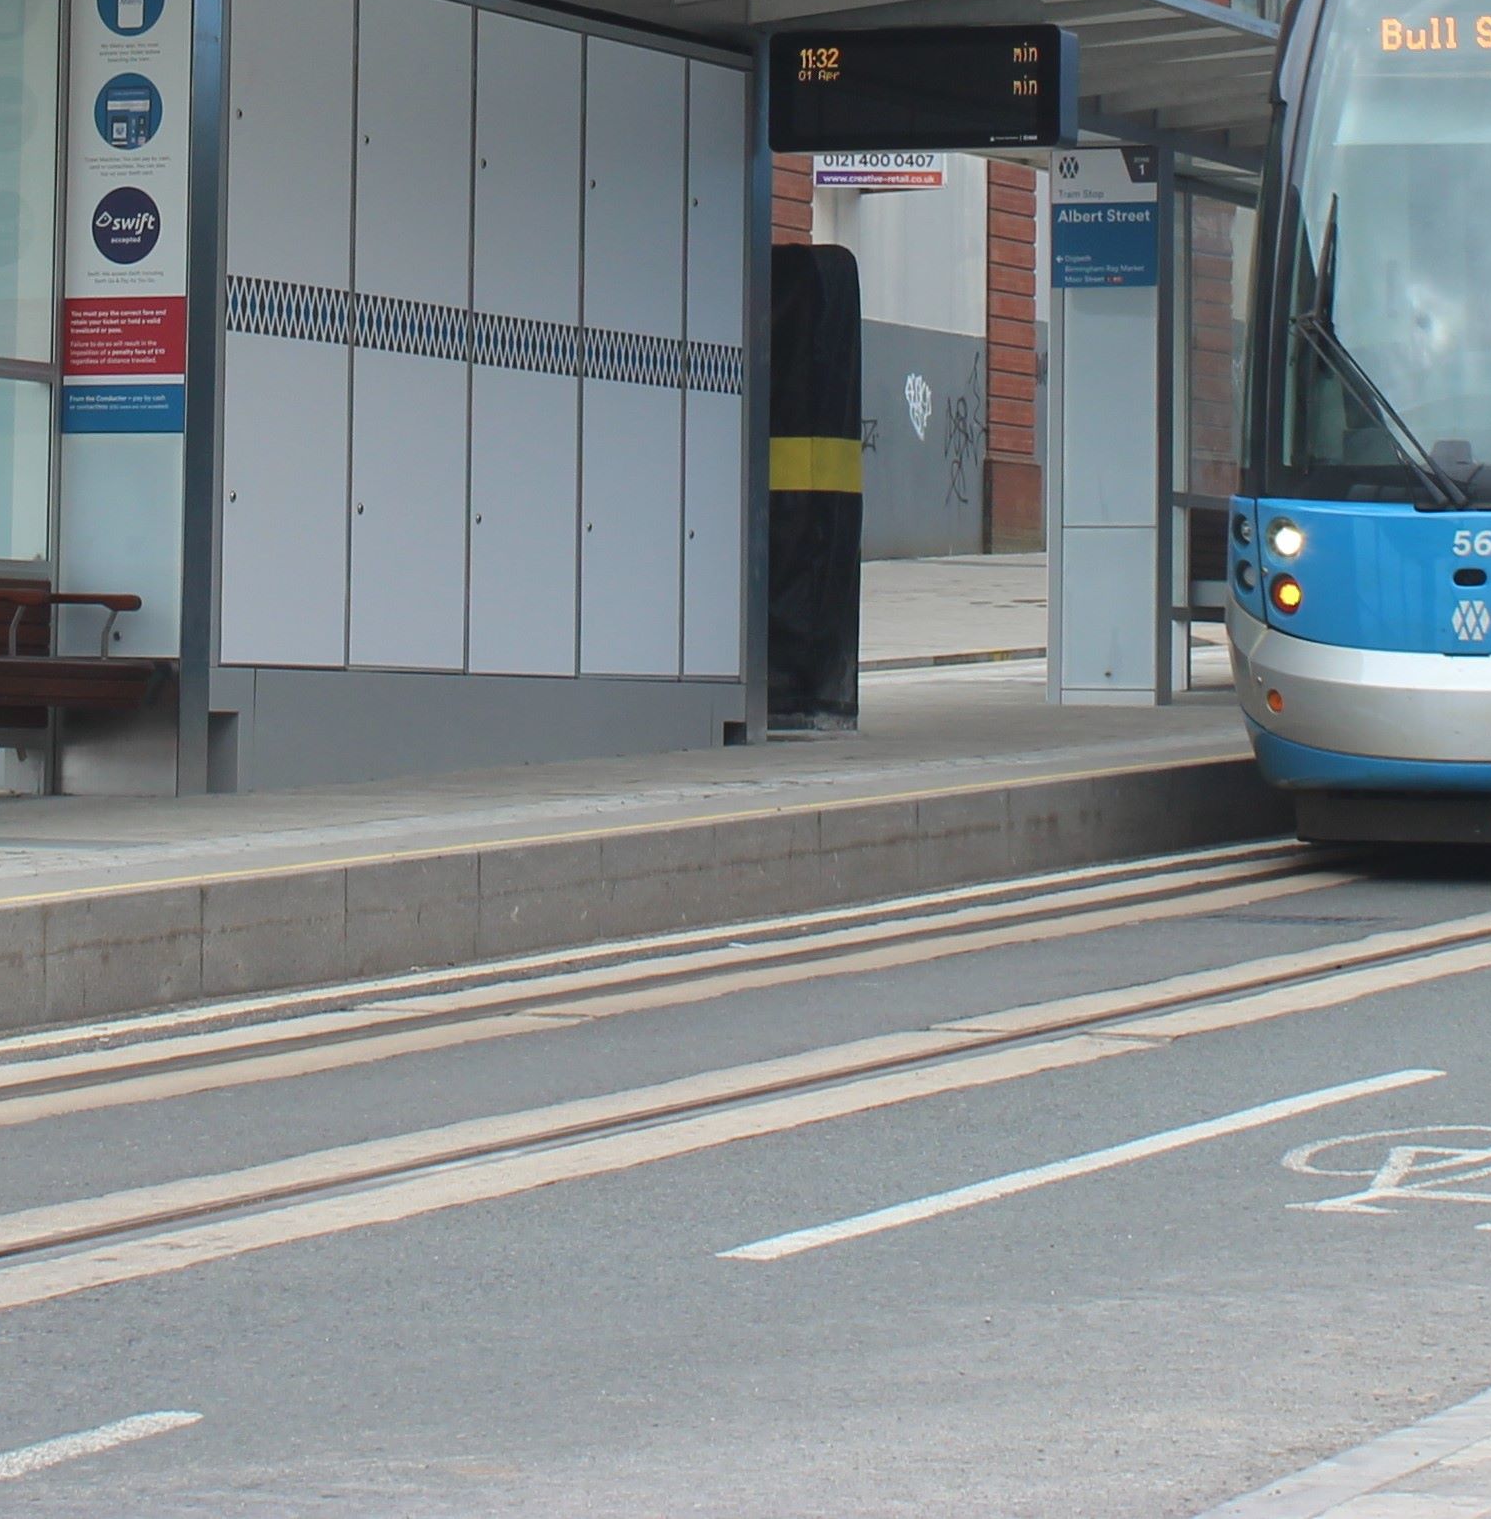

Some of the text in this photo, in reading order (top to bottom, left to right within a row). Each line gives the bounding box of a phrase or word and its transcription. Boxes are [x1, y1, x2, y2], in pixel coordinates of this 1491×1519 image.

[1381, 16, 1457, 51] Bull
[800, 48, 839, 68] 11:32
[1013, 42, 1037, 62] min
[798, 70, 840, 81] 01 Apr
[1013, 74, 1037, 95] min
[823, 154, 935, 167] 0121 400 0407
[1139, 164, 1145, 175] 1
[823, 175, 935, 184] www.creative-retail.co.uk
[1059, 189, 1104, 199] Tram Stop
[1057, 209, 1151, 223] Albert Street
[112, 213, 155, 235] swift
[111, 236, 141, 244] accepted
[1120, 264, 1145, 272] Market
